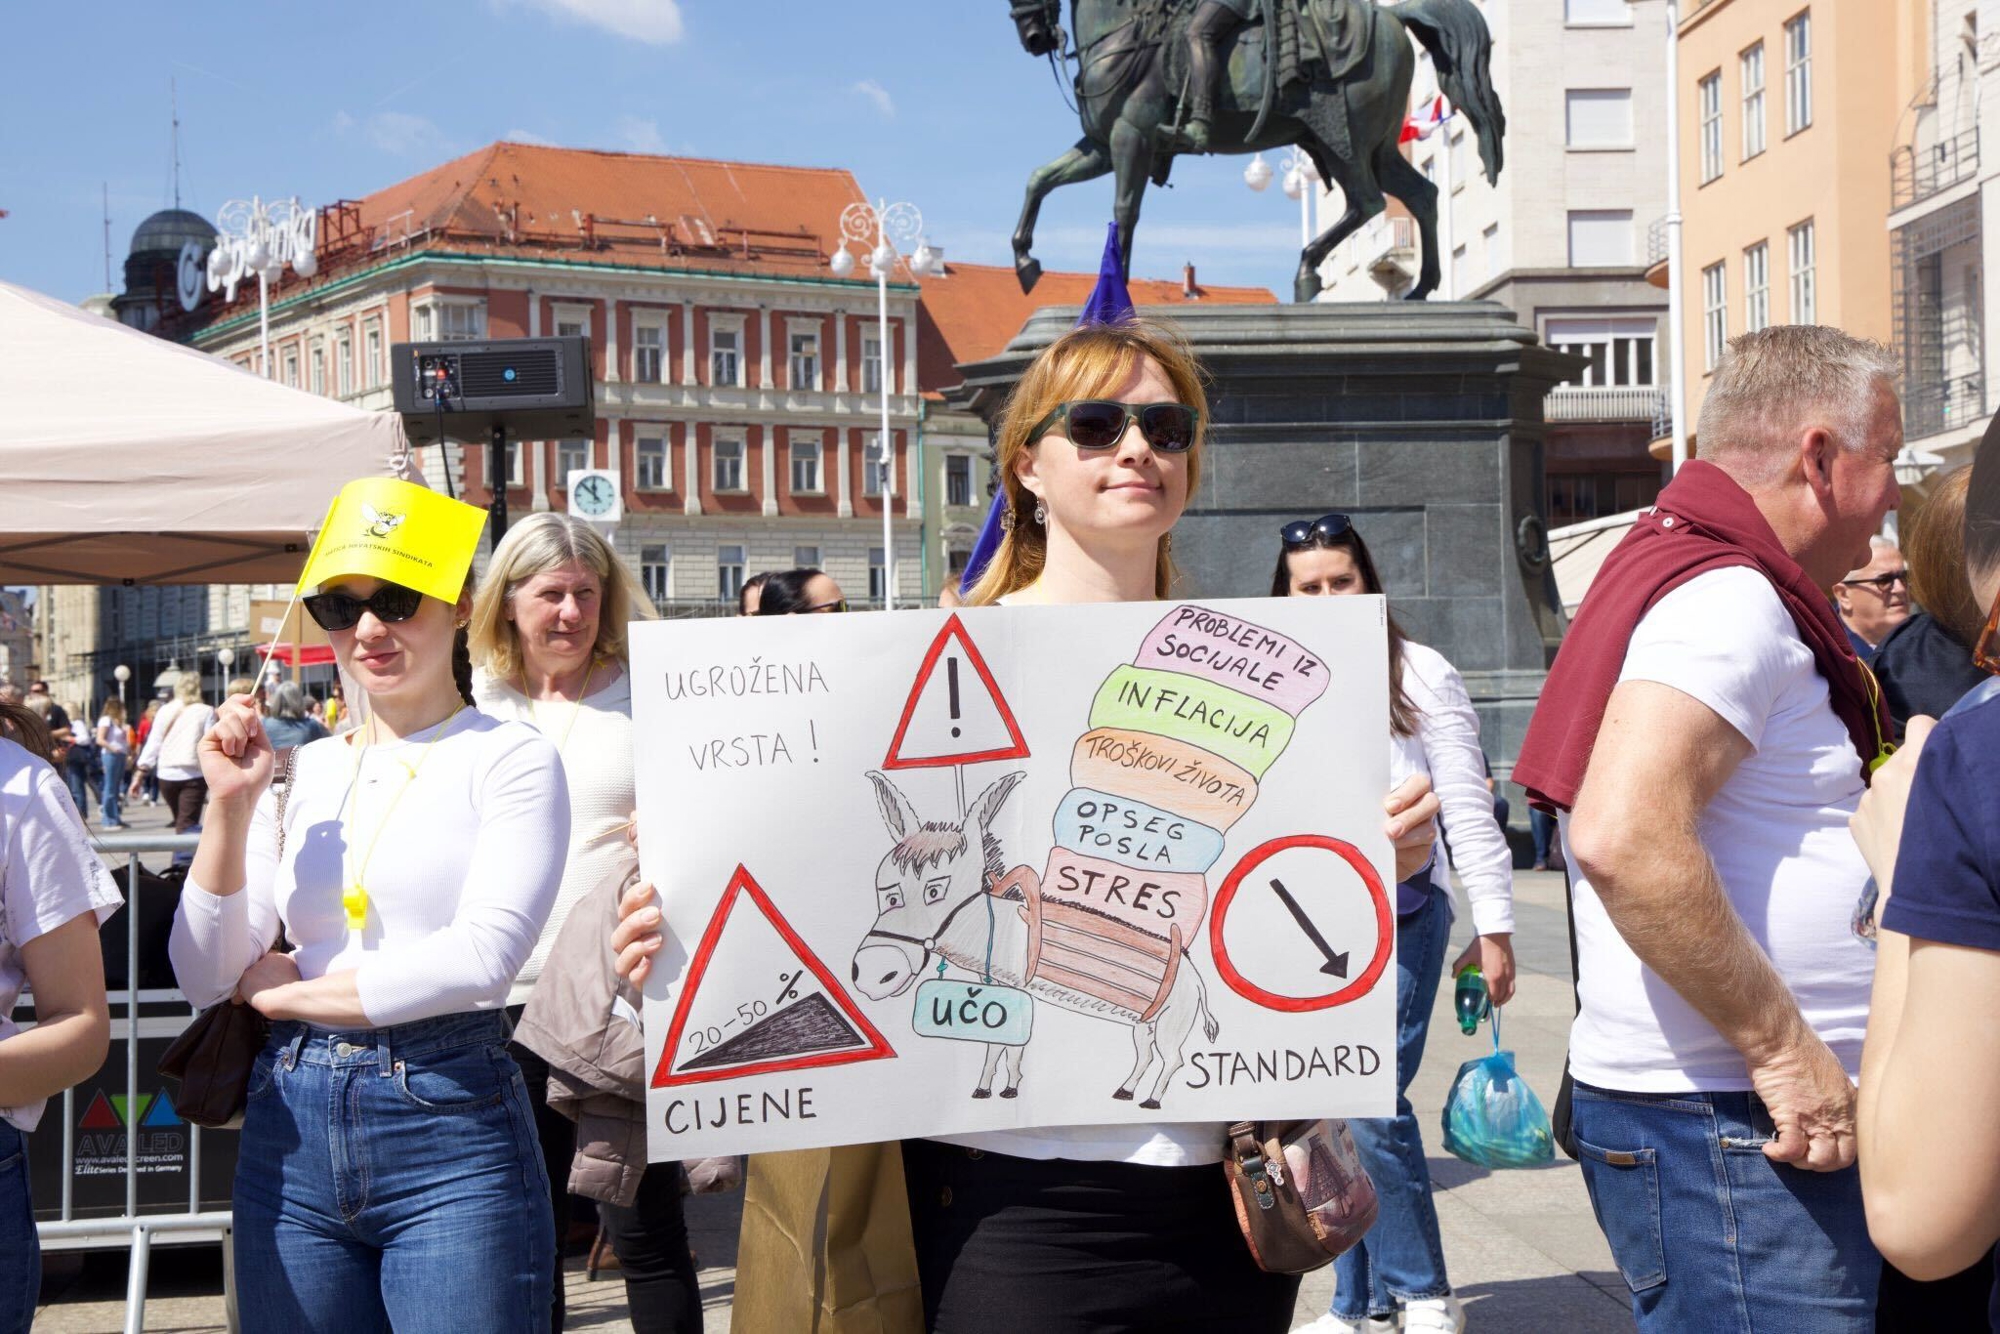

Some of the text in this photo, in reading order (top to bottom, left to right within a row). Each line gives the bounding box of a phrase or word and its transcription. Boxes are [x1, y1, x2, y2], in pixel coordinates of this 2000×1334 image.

[392, 549, 433, 568] SINDIKATA
[1157, 634, 1284, 691] SOCIJALE
[1174, 608, 1317, 677] PROBLEMI IZ
[665, 656, 829, 700] UGROŽENA
[1118, 680, 1270, 748] INFLACIJA
[689, 733, 793, 770] VRSTA
[1086, 735, 1246, 807] TROŠKOVI ŽIVOTA
[1077, 801, 1185, 840] OPSEG
[1079, 825, 1171, 864] POSLA
[1057, 866, 1181, 919] STRES
[932, 987, 1007, 1028] UČO
[1186, 1045, 1380, 1089] STANDARD
[665, 1088, 817, 1134] CIJENE
[75, 1153, 183, 1164] www.avaledcreen.com
[155, 1165, 183, 1173] Germany
